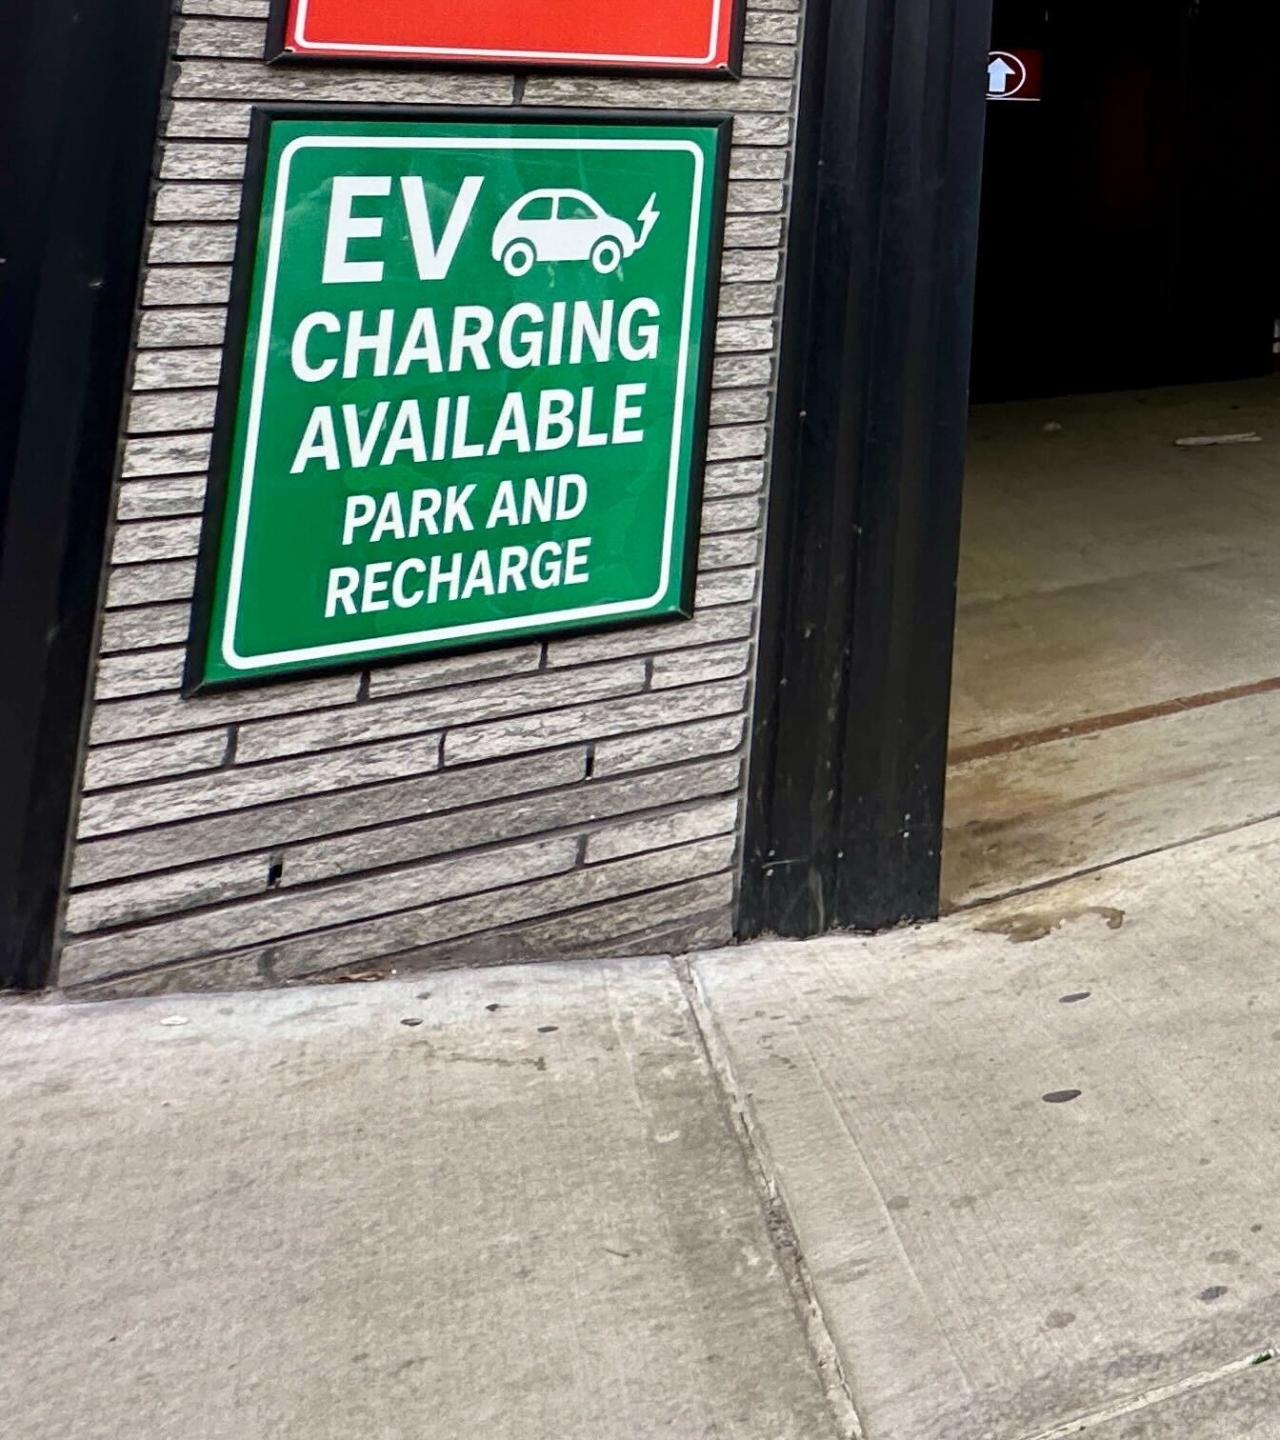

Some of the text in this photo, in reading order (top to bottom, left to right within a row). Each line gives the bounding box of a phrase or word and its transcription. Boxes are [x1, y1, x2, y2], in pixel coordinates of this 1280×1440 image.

[321, 175, 485, 284] EV
[291, 296, 660, 383] CHARGING
[290, 383, 648, 474] AVAILABLE
[342, 473, 588, 546] PARK AND
[324, 537, 592, 618] RECHARGE
